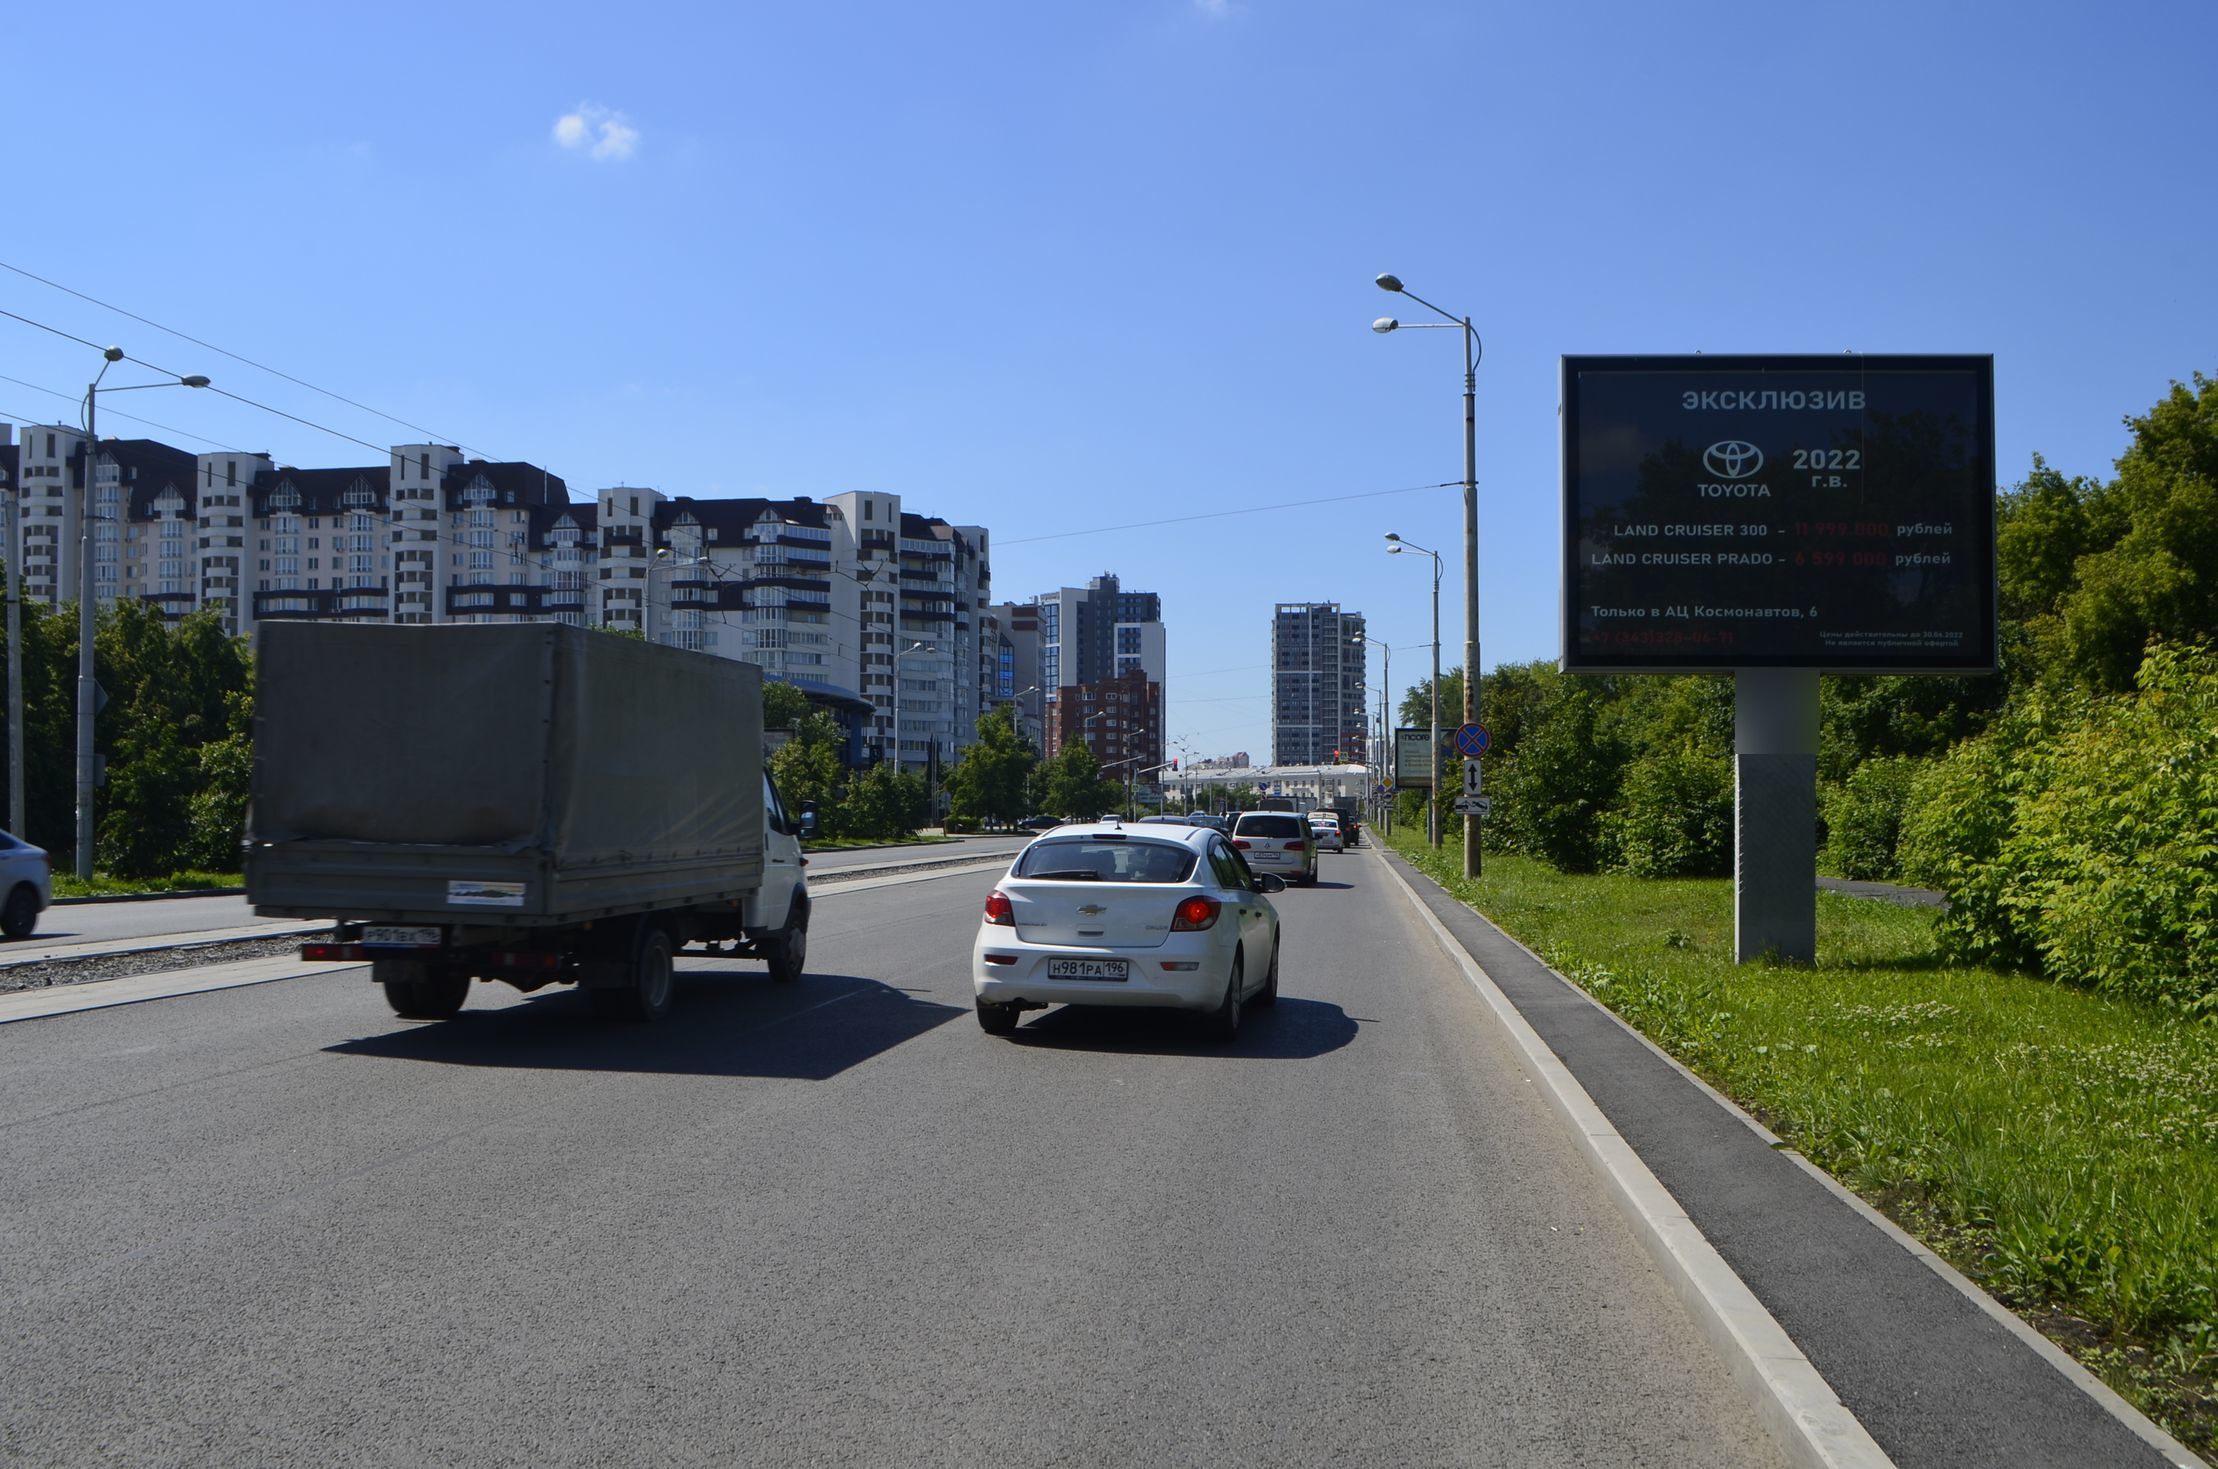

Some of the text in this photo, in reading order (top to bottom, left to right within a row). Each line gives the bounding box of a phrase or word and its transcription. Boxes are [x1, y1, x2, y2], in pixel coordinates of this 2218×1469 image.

[1682, 390, 1867, 410] ЭКСКЛЮЗИВ
[1792, 449, 1861, 470] 2022
[1697, 483, 1771, 498] TOYOTA
[1614, 524, 1659, 537] LAND
[1664, 524, 1734, 537] CRUISER
[1739, 524, 1768, 537] 300
[1896, 522, 1953, 538] рублей
[1591, 553, 1637, 565] LAND
[1641, 553, 1712, 565] CRUISER
[1717, 553, 1773, 565] PRADO
[1895, 551, 1951, 567] рублей
[1591, 605, 1818, 619] Только в АЦ Космонавтов, 6
